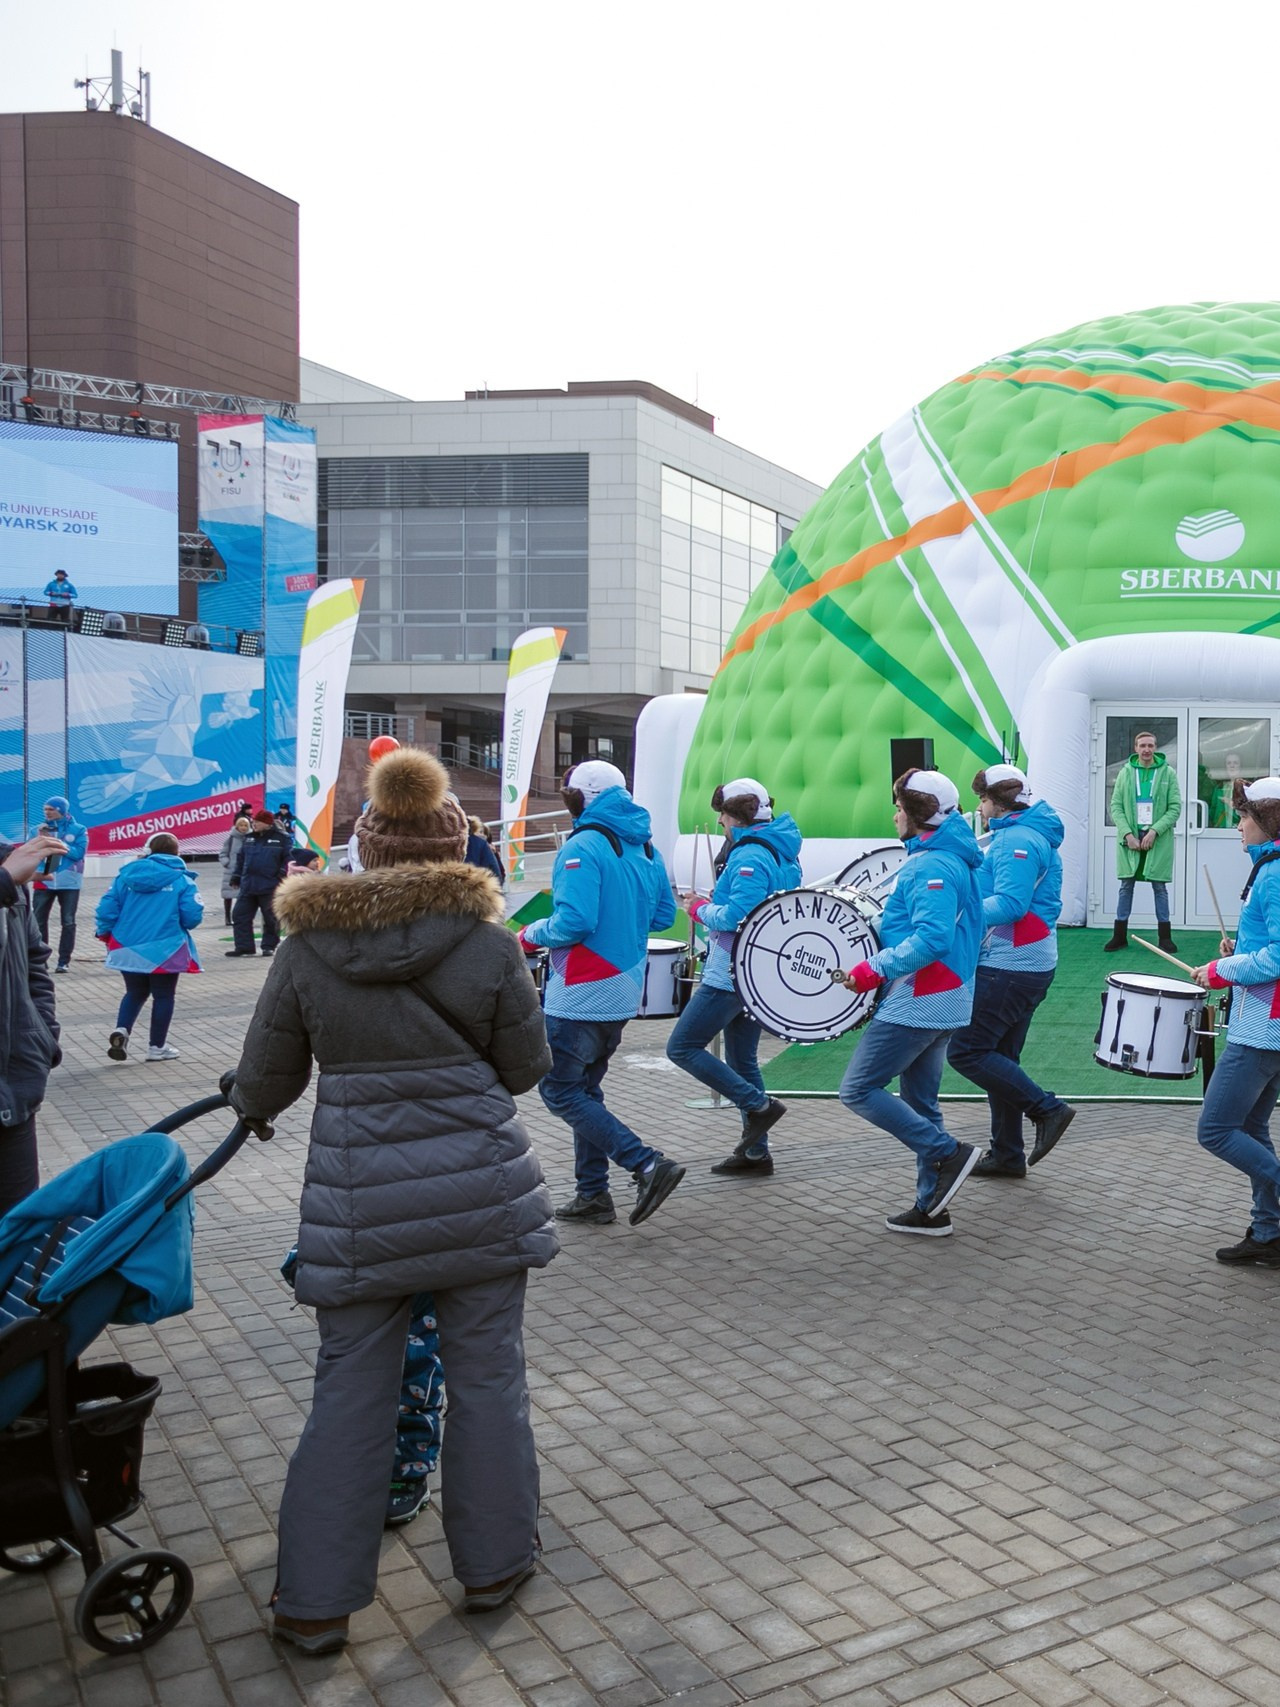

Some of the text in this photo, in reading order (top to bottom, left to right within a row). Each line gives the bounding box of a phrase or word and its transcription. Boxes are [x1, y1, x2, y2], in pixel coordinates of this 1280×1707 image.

[221, 487, 241, 496] FISU
[10, 503, 99, 521] UNIVERSIADE
[0, 515, 99, 535] YARSK 2019
[308, 680, 324, 769] SBERBANK
[505, 708, 525, 780] SBERBANK
[108, 799, 245, 842] #KRASNOYARSK2019
[795, 945, 827, 968] drum
[791, 960, 823, 980] show
